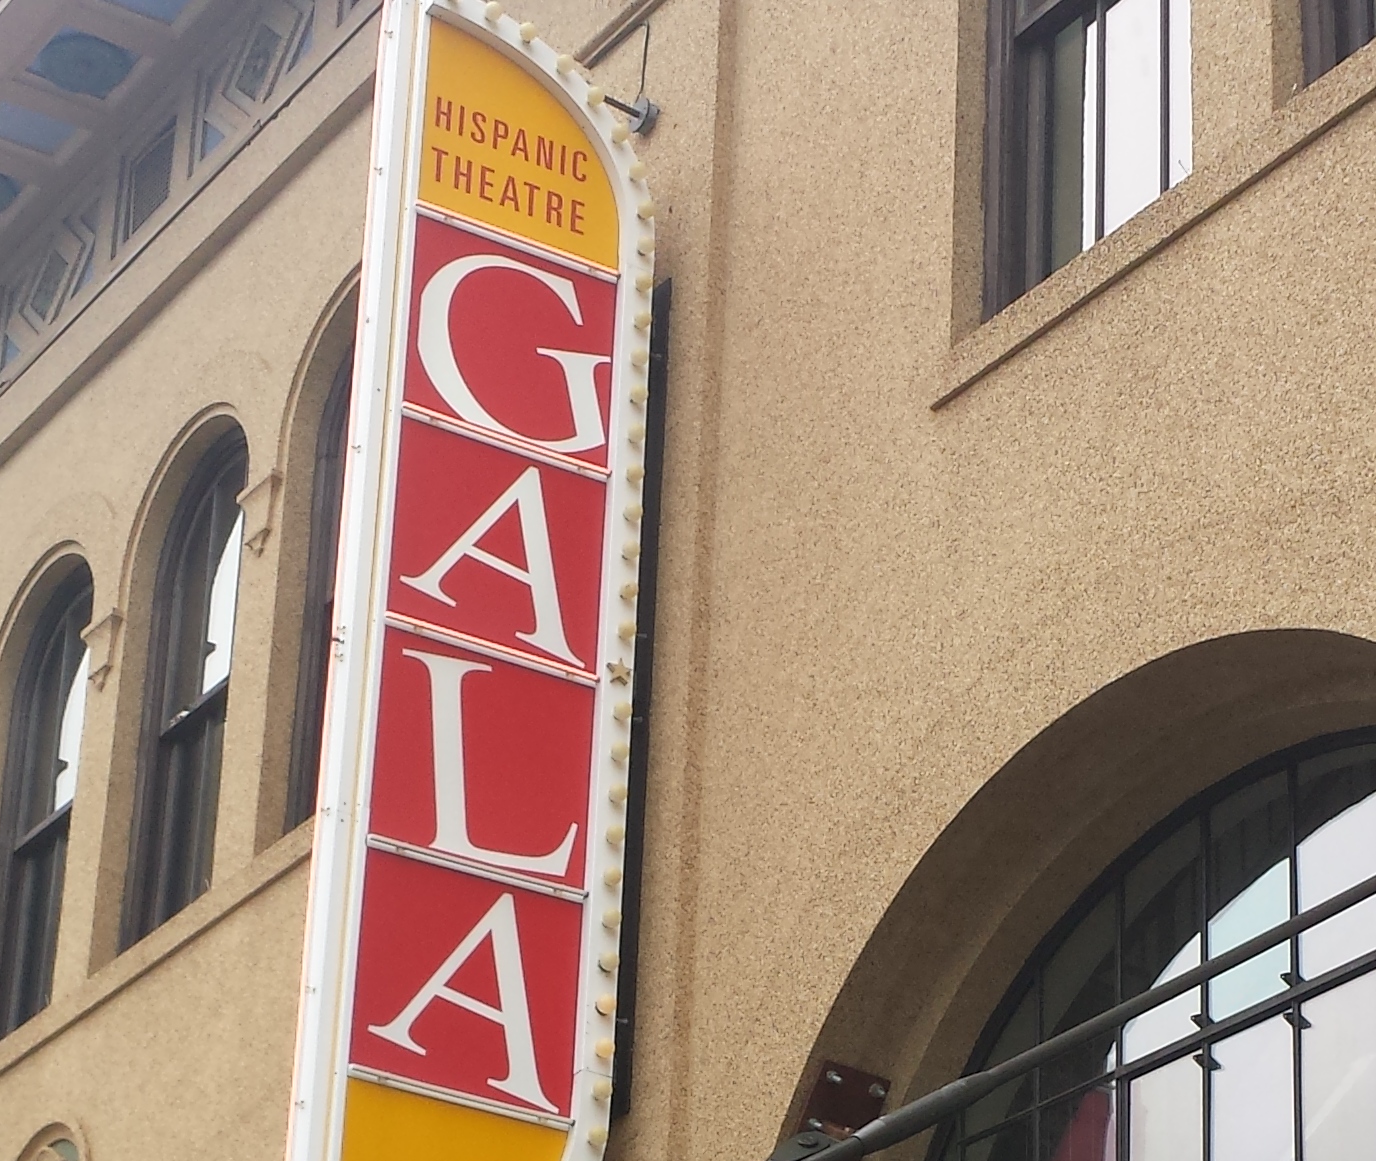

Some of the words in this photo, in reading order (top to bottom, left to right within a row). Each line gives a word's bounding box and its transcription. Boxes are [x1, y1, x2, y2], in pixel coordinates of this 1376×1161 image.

[435, 96, 588, 182] HISPANIC
[432, 147, 585, 236] THEATRE
[367, 253, 612, 1115] GALA
